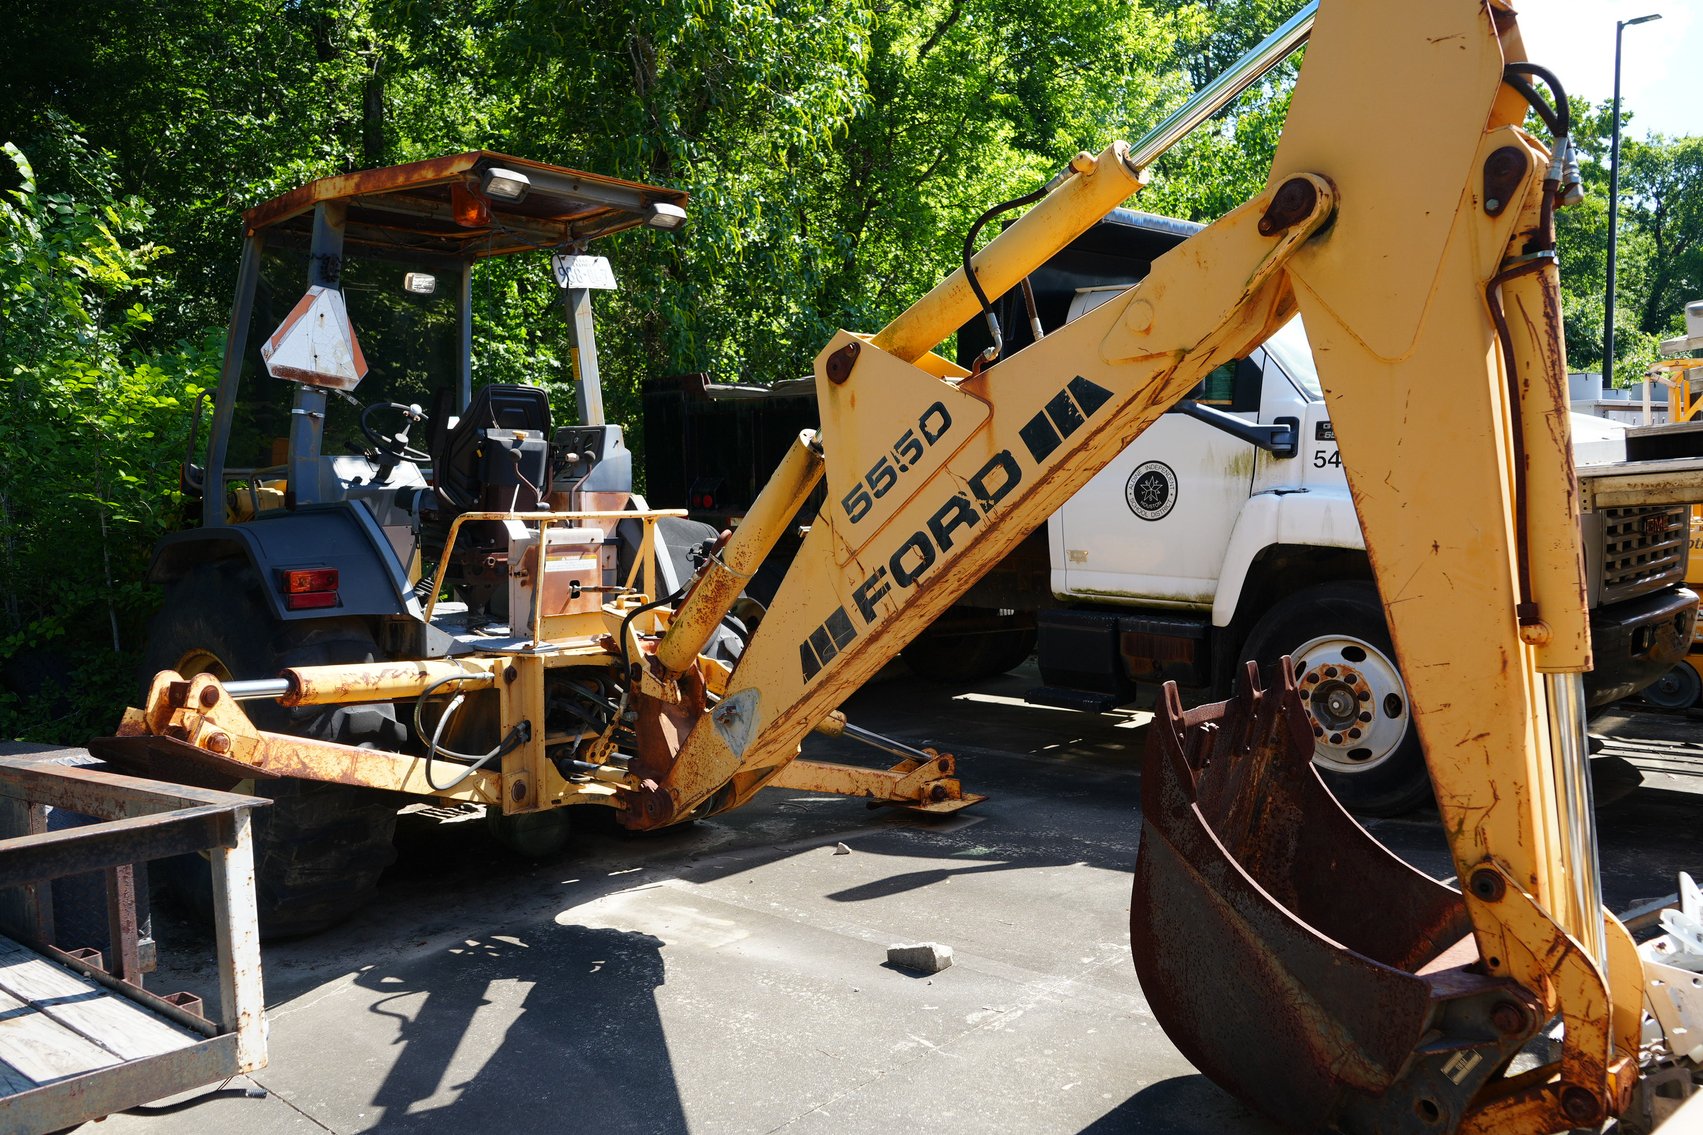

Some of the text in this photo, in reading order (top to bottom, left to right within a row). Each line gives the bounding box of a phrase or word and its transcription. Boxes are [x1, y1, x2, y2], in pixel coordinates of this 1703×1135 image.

[1129, 464, 1175, 490] ALDINE INDEPENDENT
[1129, 497, 1173, 518] SCHOOL DISTRICT
[1140, 500, 1162, 509] HOUSTON
[852, 449, 1022, 625] FORD
